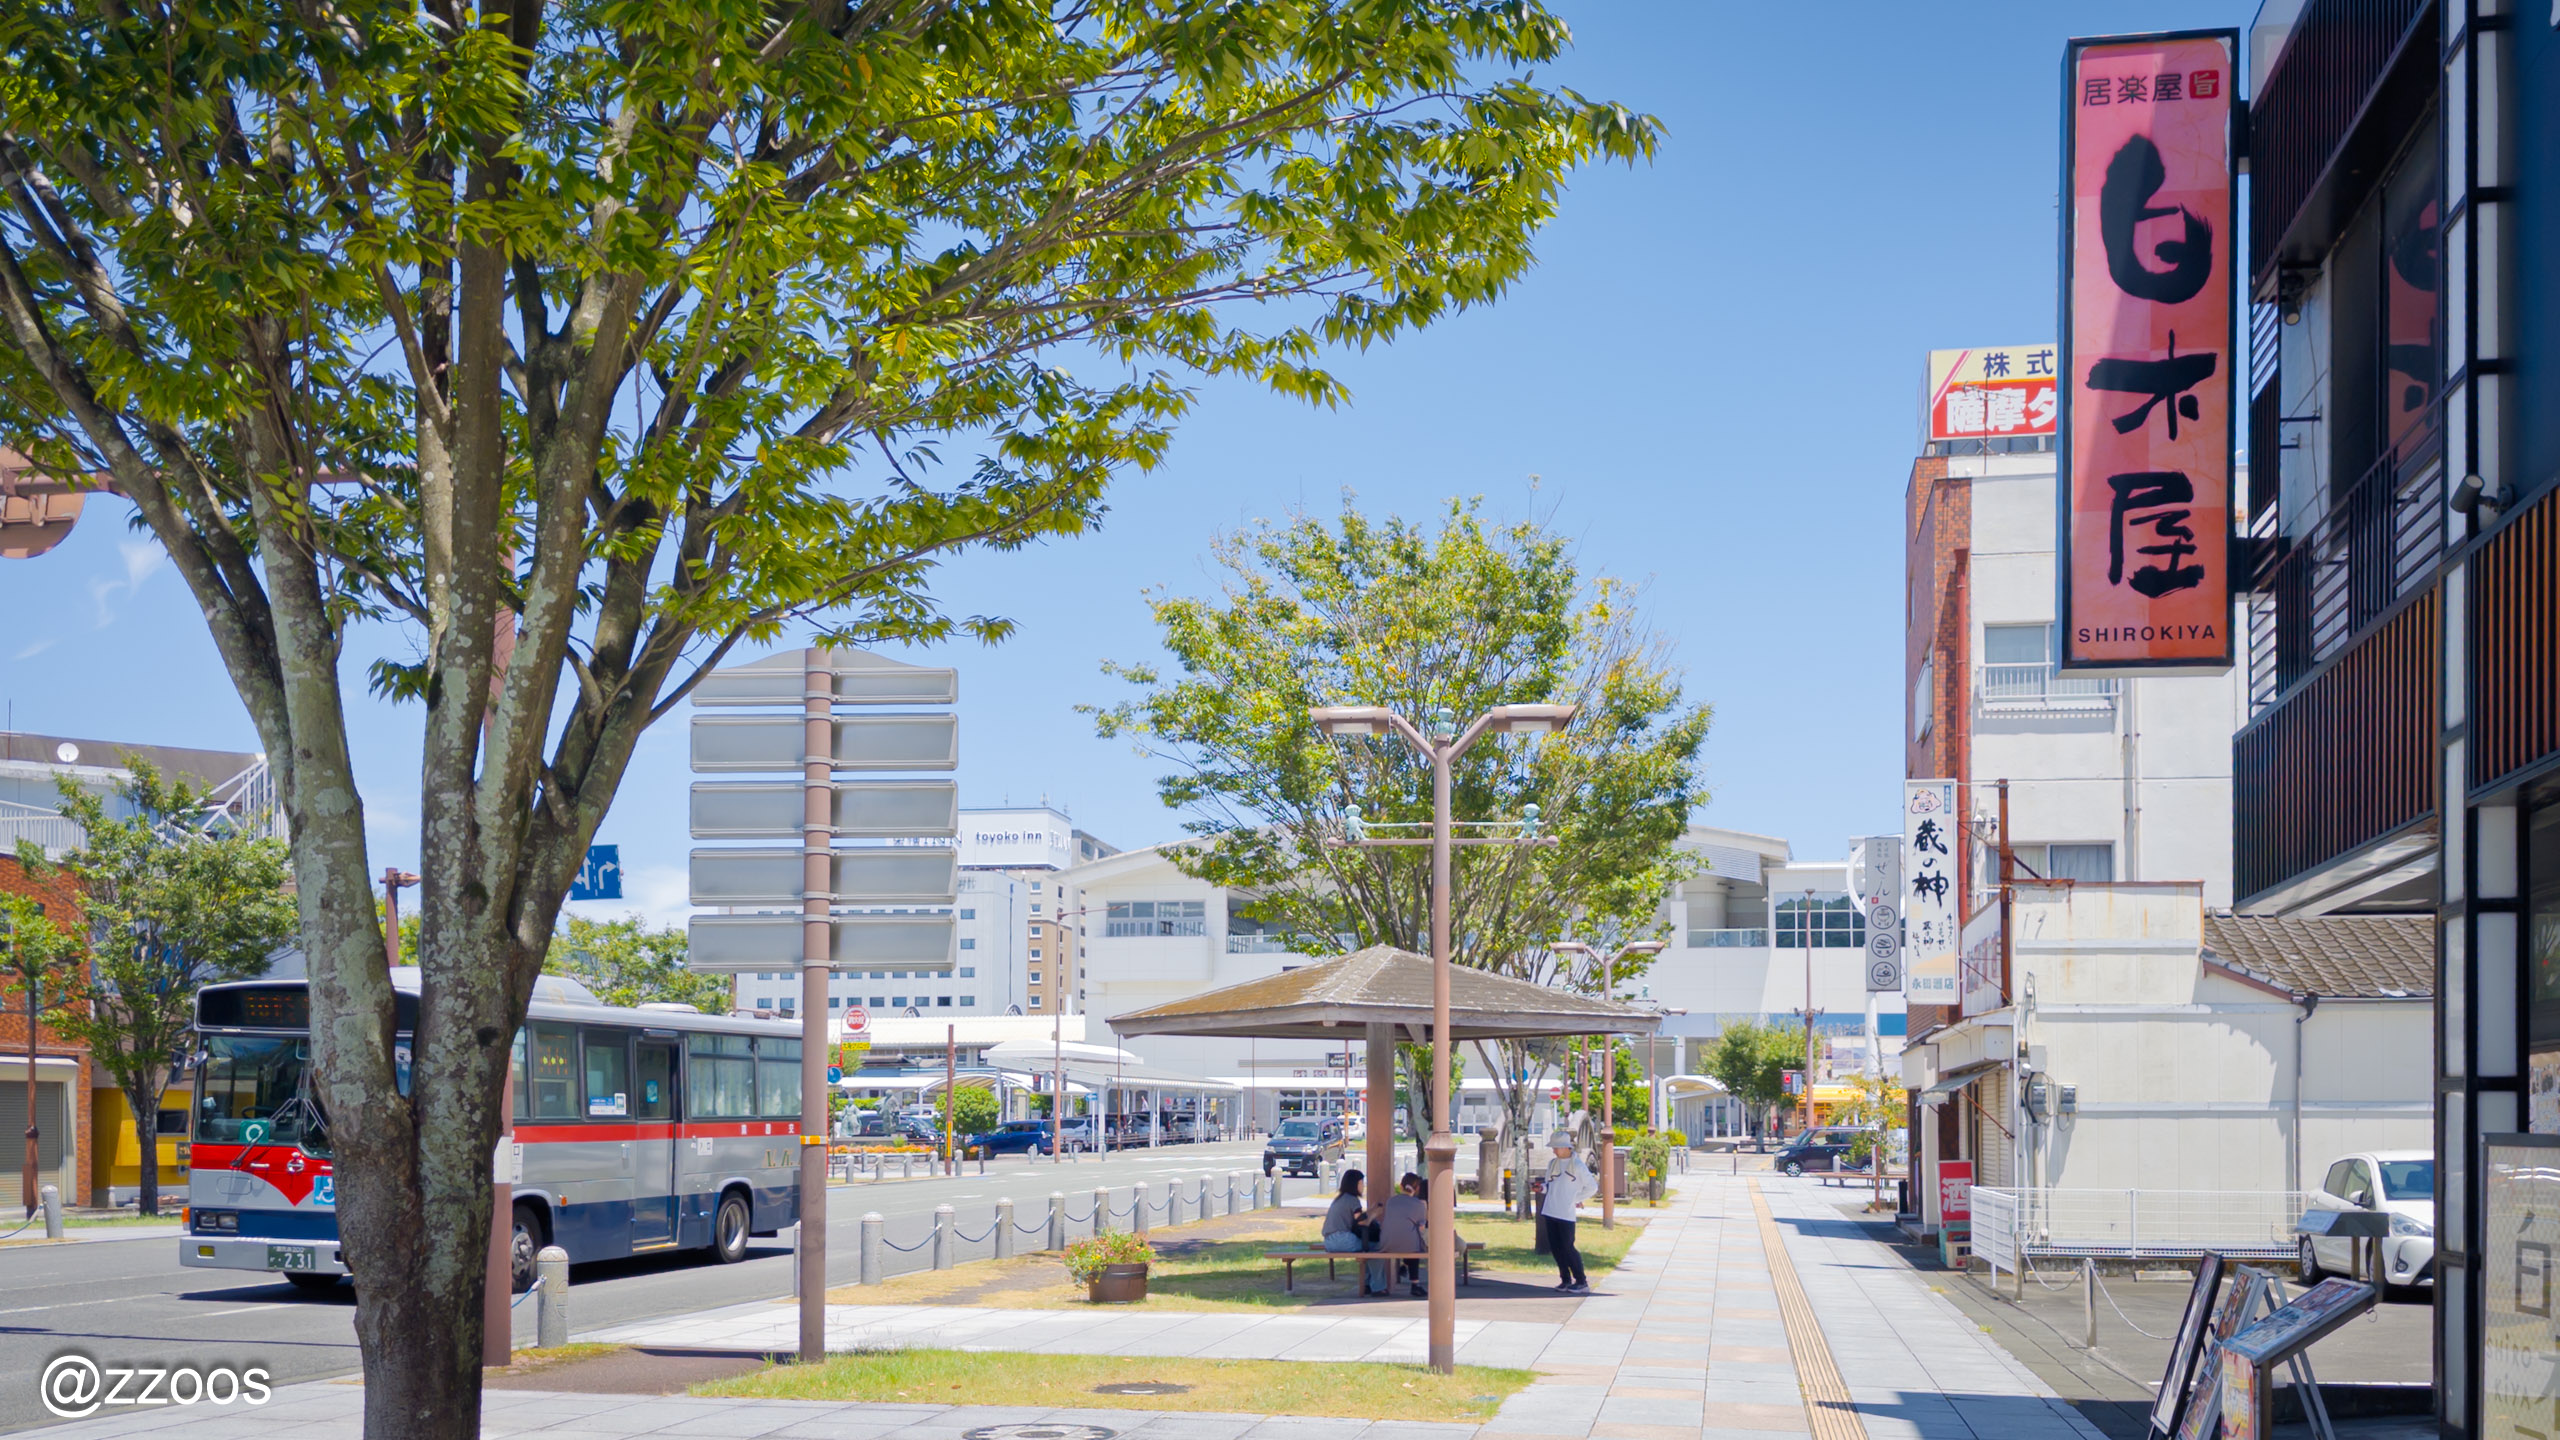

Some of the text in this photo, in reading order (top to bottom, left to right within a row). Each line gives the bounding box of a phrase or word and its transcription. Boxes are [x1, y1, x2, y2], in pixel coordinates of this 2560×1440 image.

[2083, 73, 2183, 107] 居楽屋
[2085, 132, 2218, 599] 白木屋
[2077, 623, 2217, 644] SHIROKIYA
[976, 830, 1043, 845] toyoko inn
[1911, 818, 1950, 909] 蔵の神
[1941, 1177, 1972, 1213] 酒
